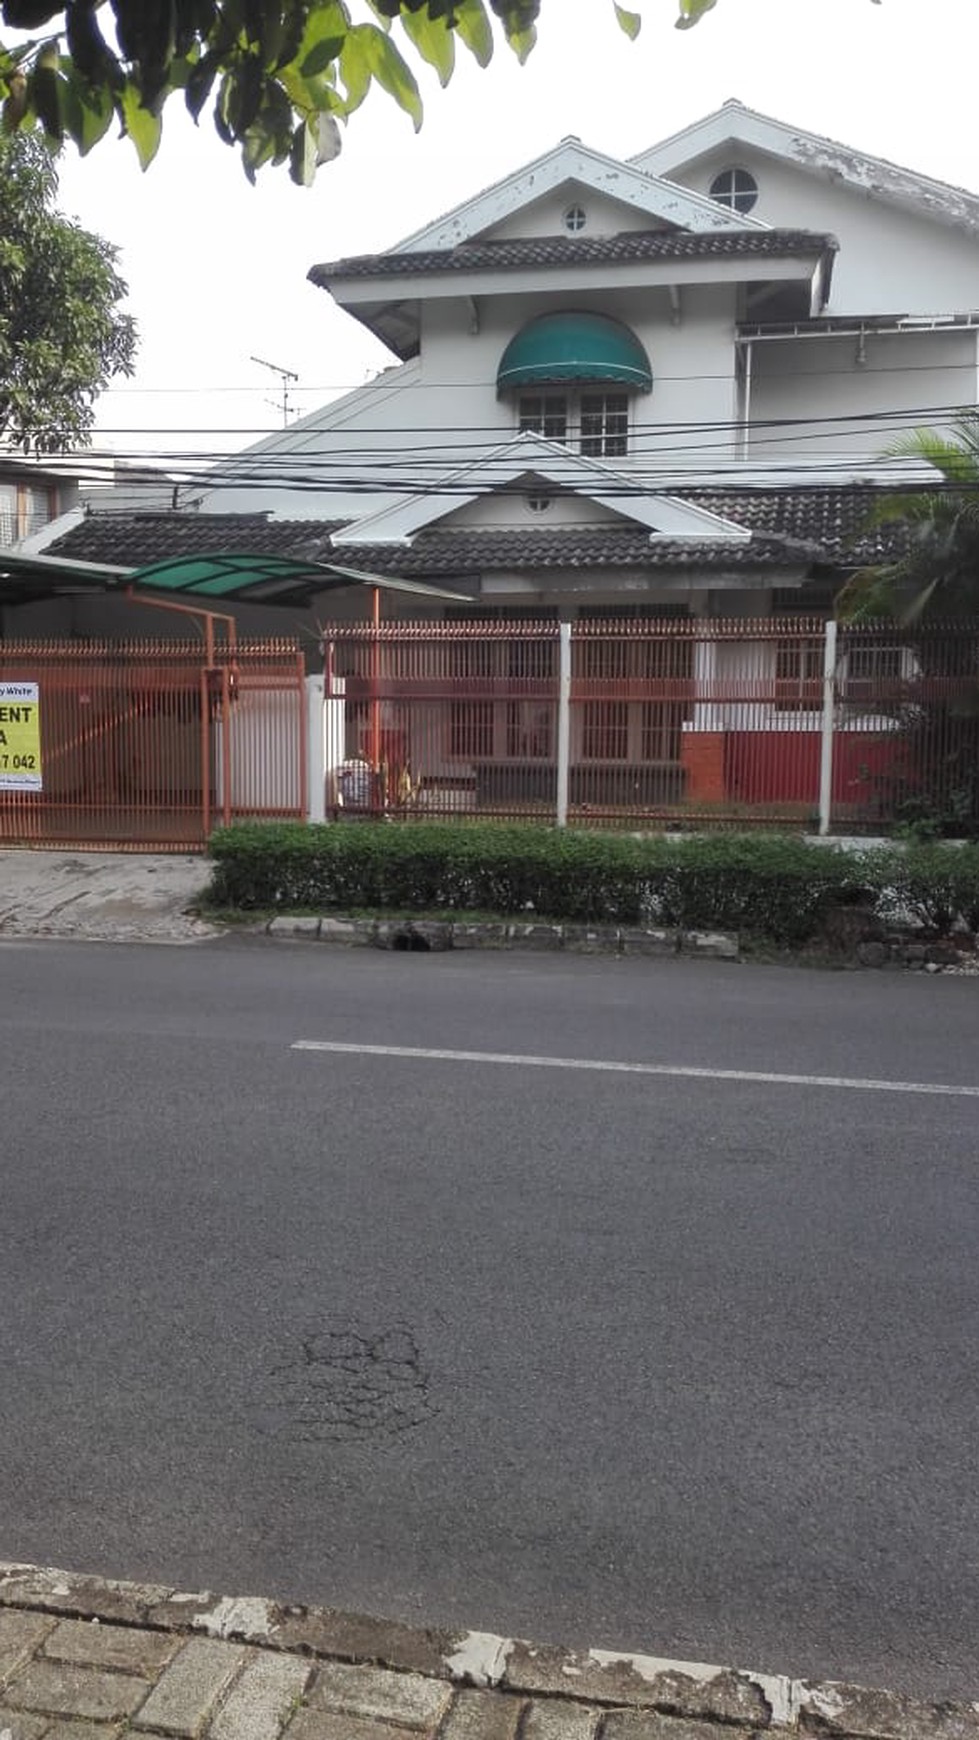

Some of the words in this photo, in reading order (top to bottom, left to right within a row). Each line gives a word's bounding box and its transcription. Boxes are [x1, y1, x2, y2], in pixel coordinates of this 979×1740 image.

[7, 687, 32, 695] White
[0, 755, 9, 769] 7
[13, 755, 35, 769] 042
